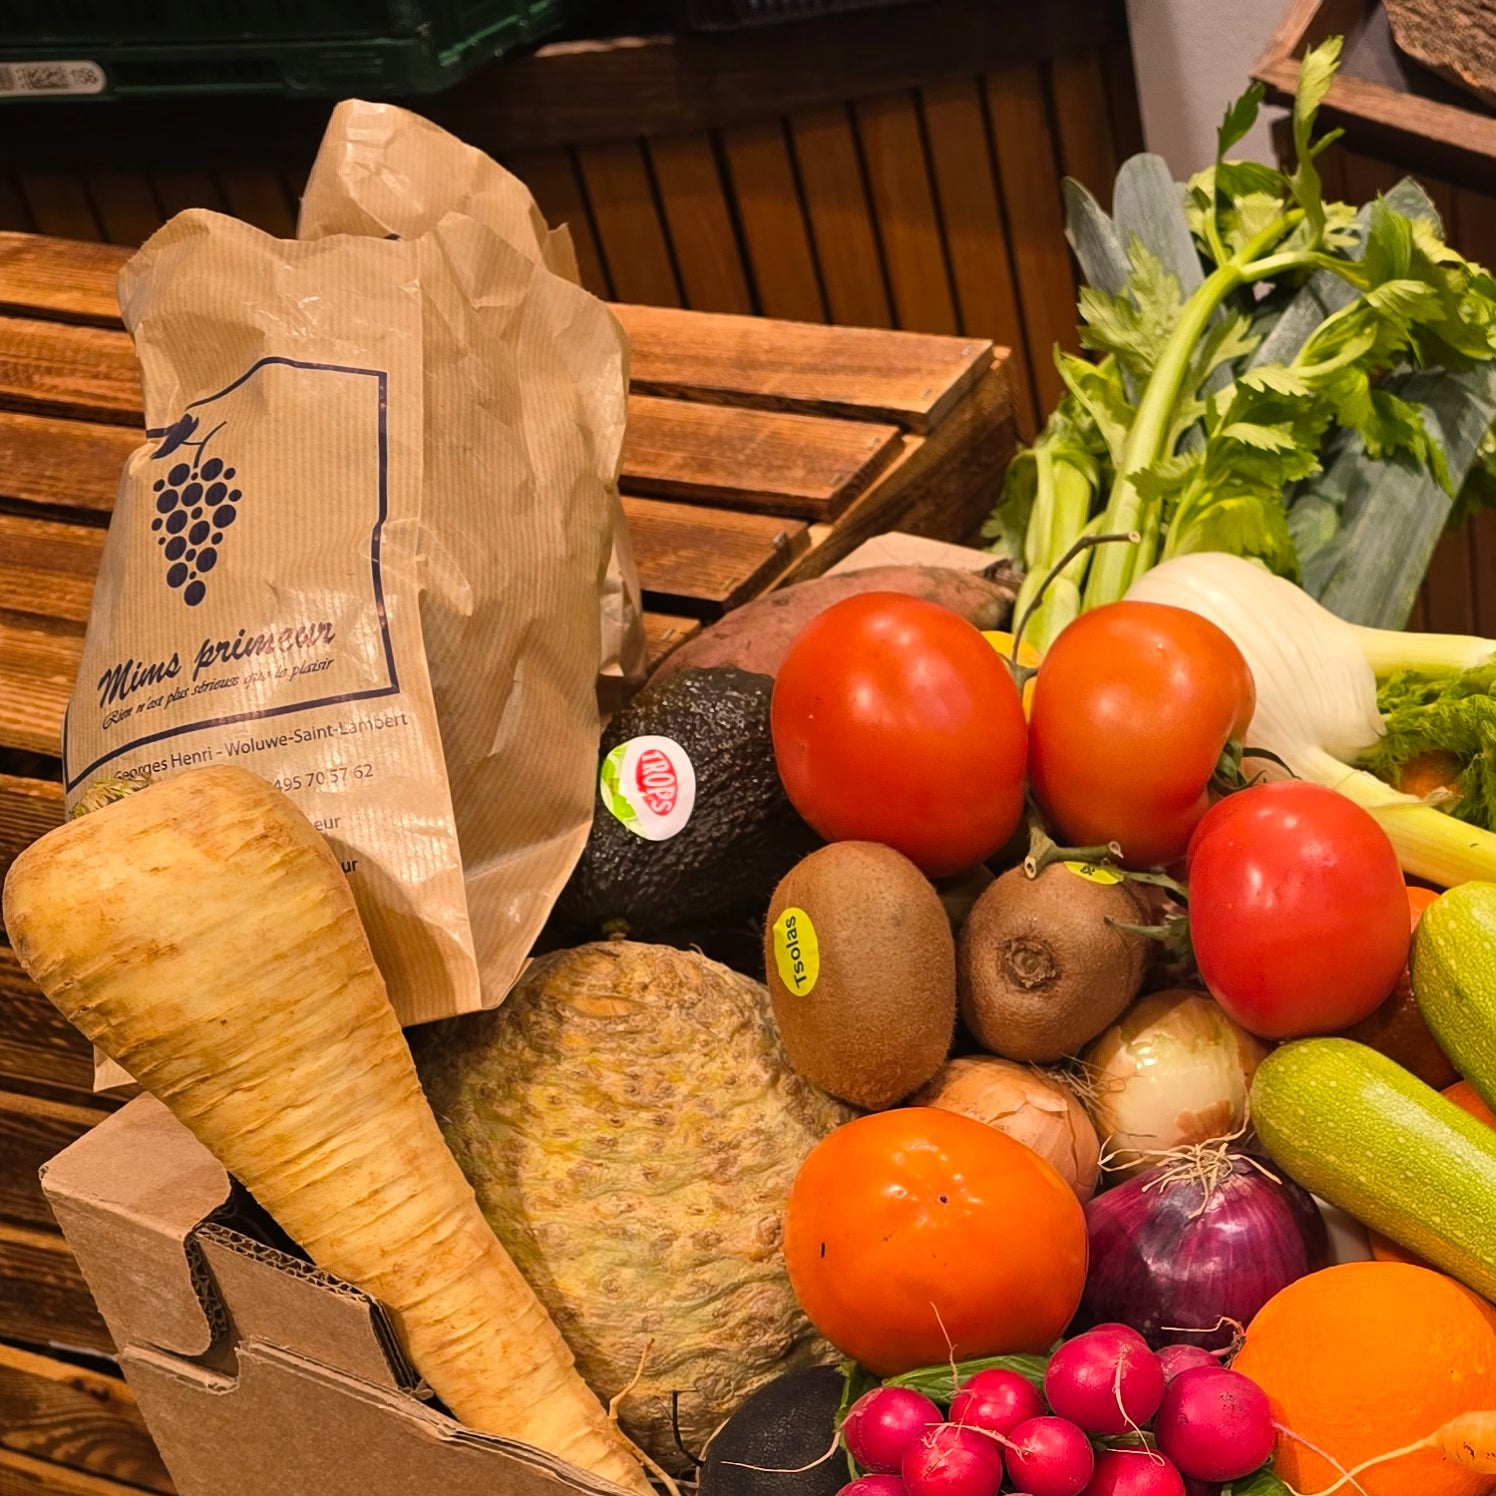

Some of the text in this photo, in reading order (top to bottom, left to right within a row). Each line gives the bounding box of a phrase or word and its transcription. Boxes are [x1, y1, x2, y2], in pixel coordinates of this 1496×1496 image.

[97, 622, 336, 708] Mims primeur
[164, 687, 189, 709] plus
[289, 658, 334, 681] plaisir
[171, 746, 213, 768] Henri
[224, 713, 408, 757] Woluwe-Saint-Lambert
[274, 763, 374, 792] 495 70 57 62
[641, 752, 674, 816] TROPS
[785, 915, 807, 990] Tsolas
